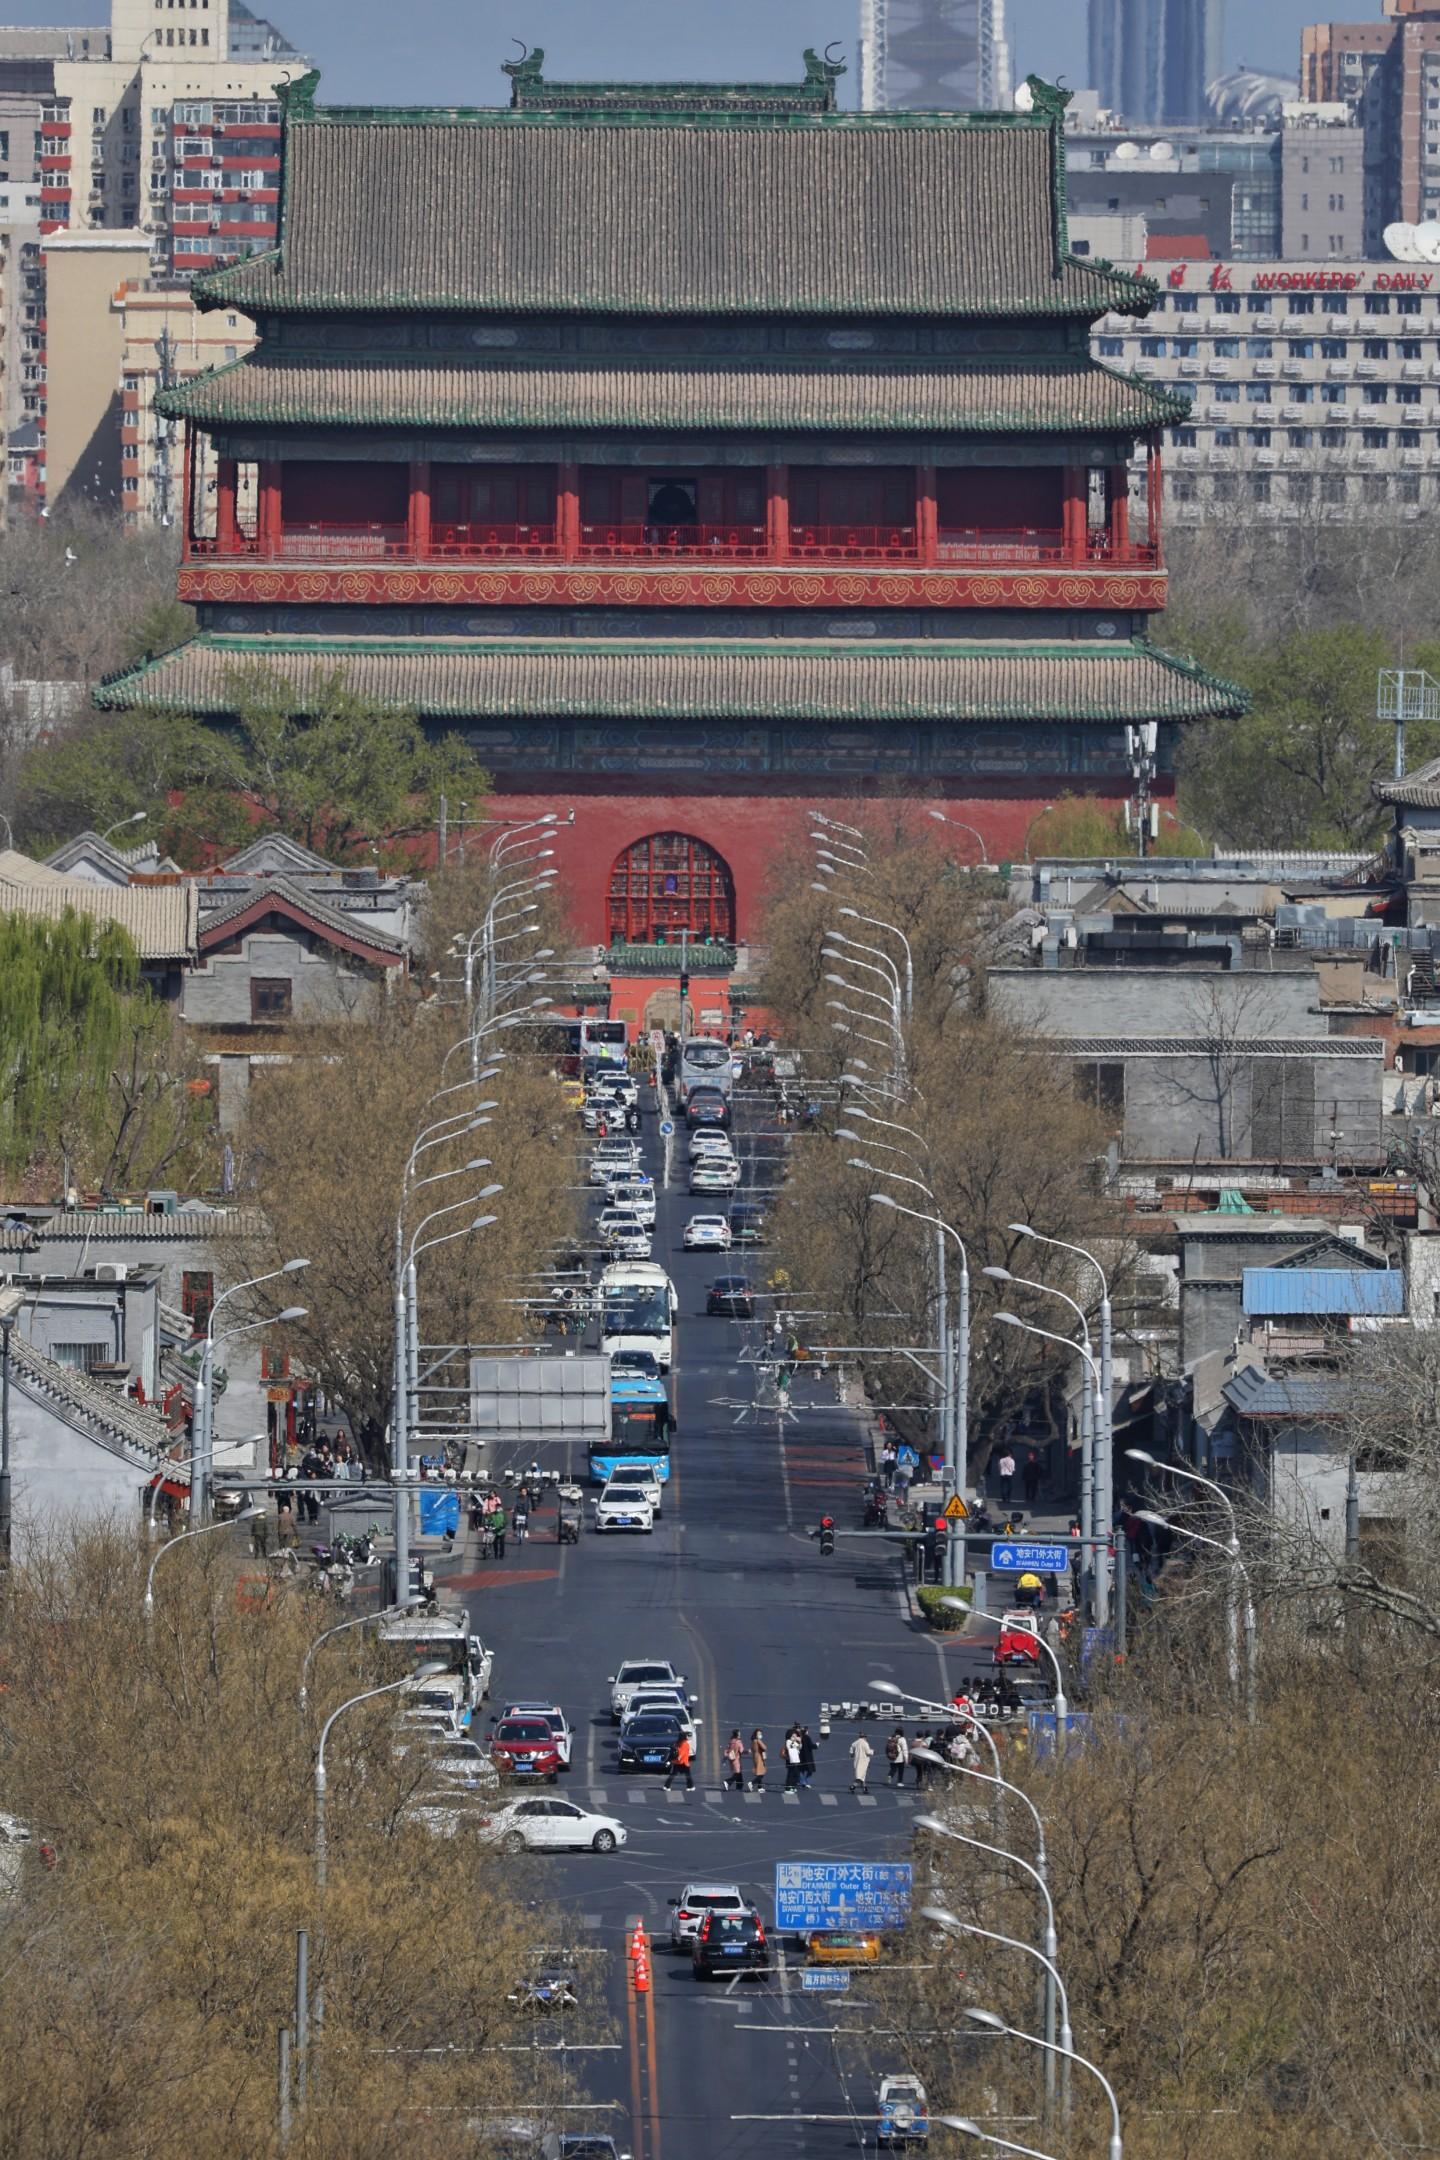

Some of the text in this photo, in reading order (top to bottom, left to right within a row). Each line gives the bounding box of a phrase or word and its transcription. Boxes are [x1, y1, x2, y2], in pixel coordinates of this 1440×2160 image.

[1256, 271, 1434, 289] WORKERS' DAILY
[1017, 1548, 1062, 1560] 地安门外大街
[802, 1866, 874, 1881] 地安门外大街
[779, 1890, 831, 1905] 地安门西大街
